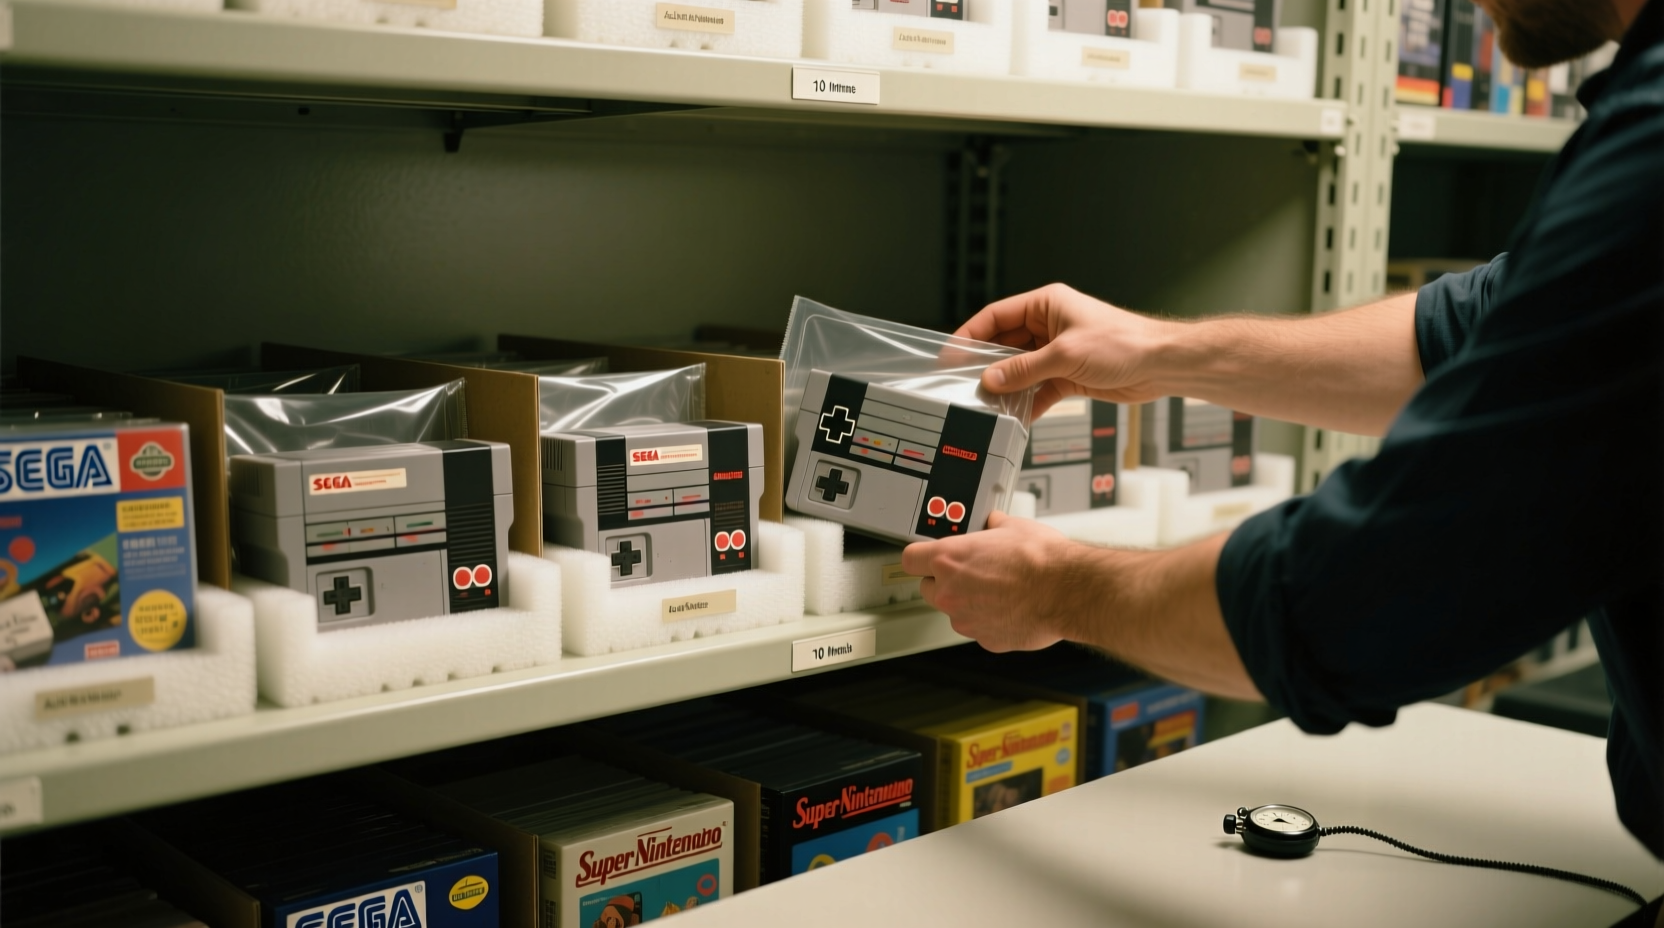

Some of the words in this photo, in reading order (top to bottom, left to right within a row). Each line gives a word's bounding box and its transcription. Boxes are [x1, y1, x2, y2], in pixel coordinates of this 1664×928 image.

[813, 79, 826, 92] 10
[812, 646, 825, 660] 10
[793, 797, 840, 830] Super
[576, 850, 635, 888] Super
